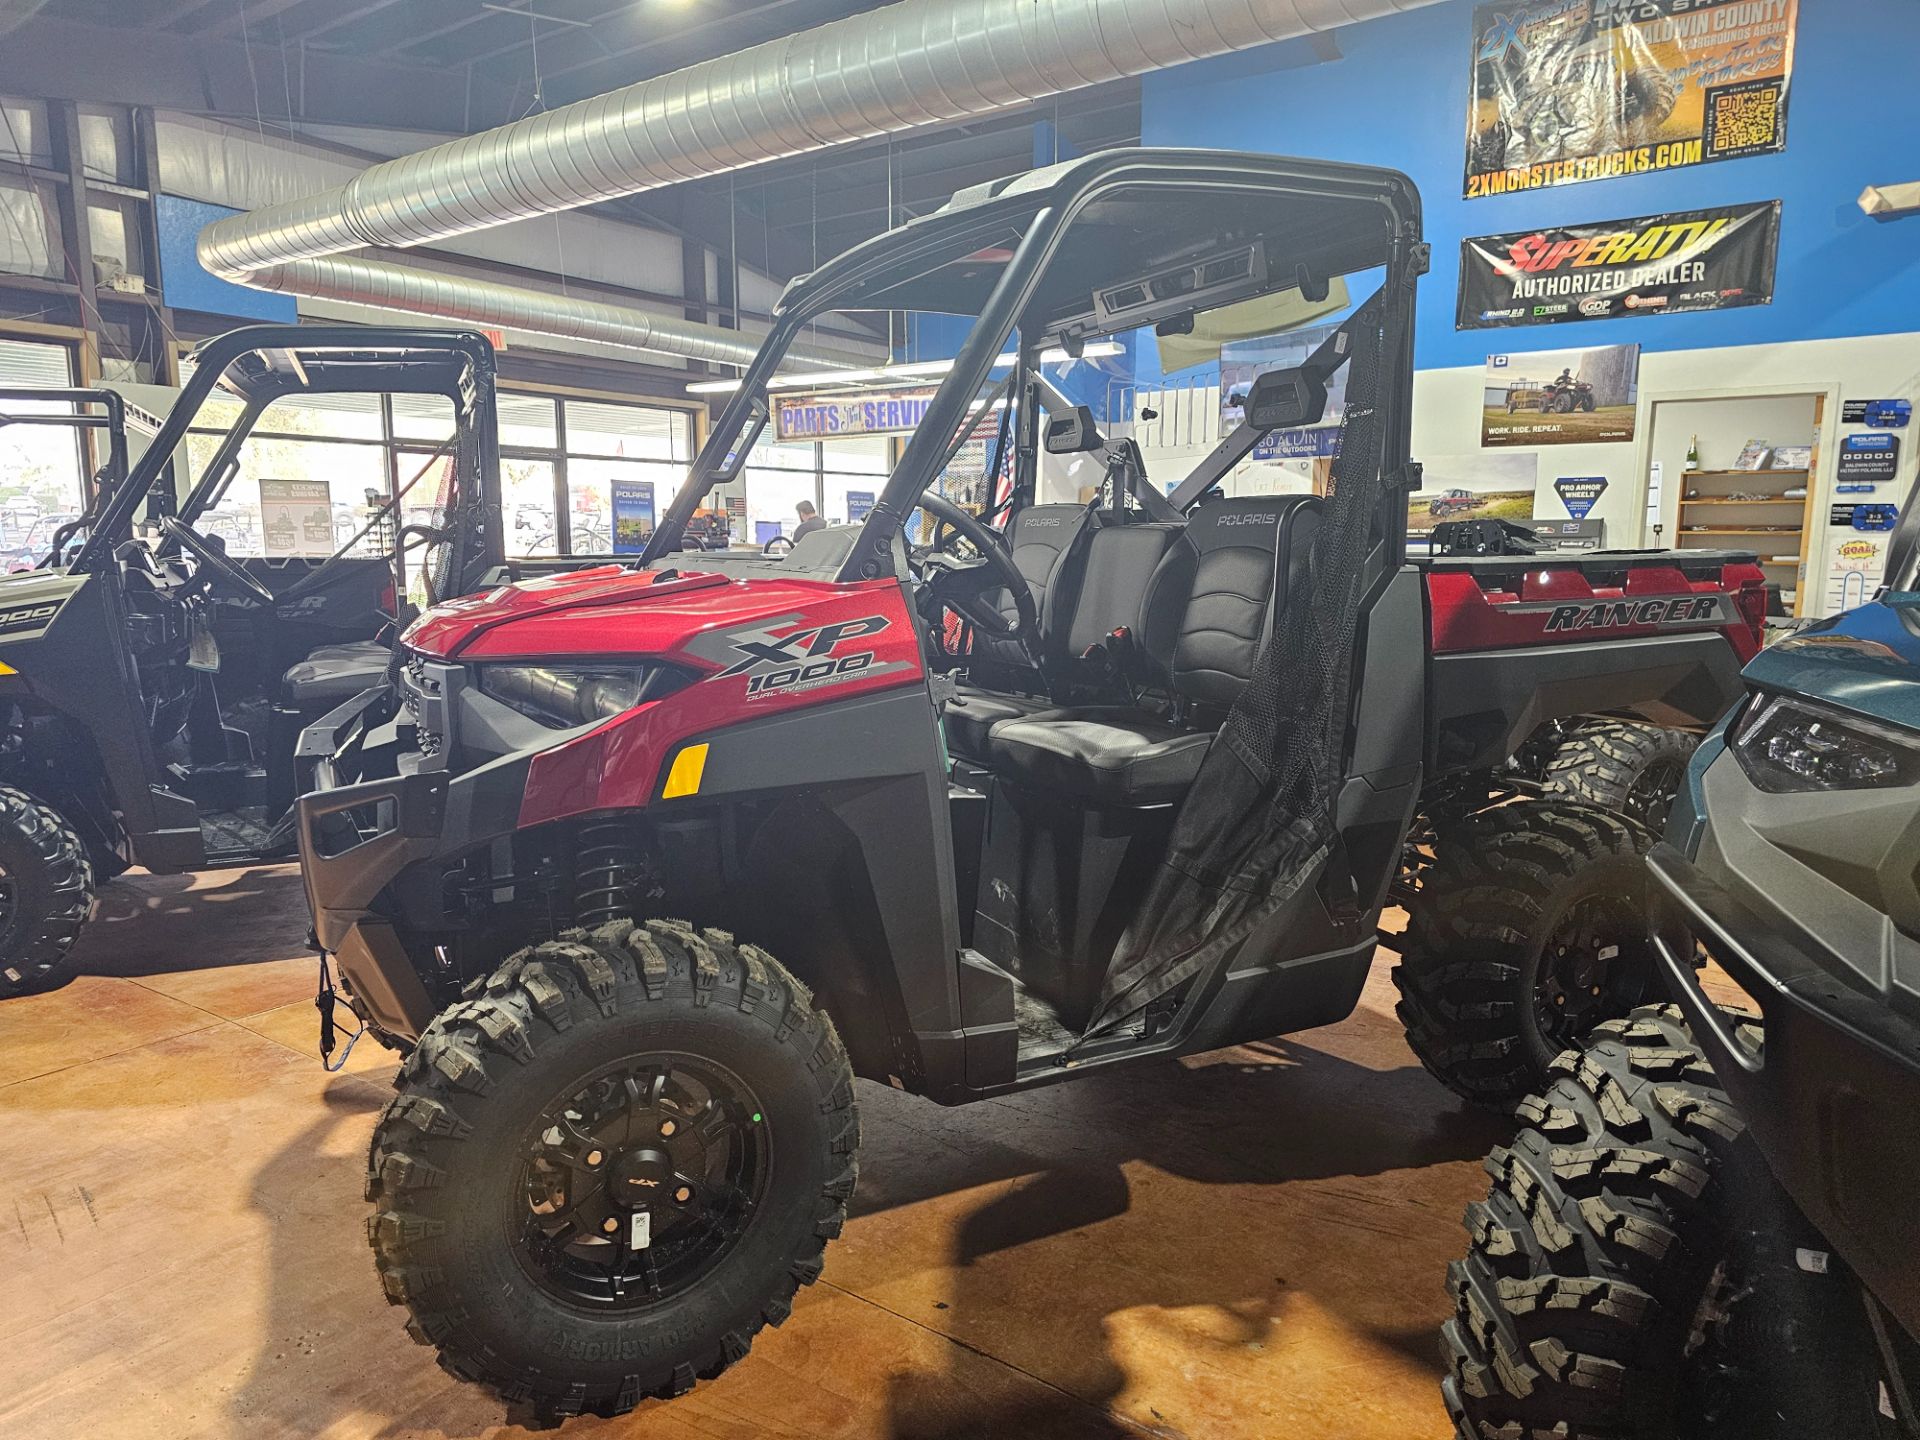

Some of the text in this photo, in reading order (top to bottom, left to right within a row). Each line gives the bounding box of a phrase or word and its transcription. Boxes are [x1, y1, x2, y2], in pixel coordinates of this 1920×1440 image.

[1636, 0, 1788, 46] ALDWIN COUNTY
[1753, 21, 1787, 38] ARENA
[1467, 138, 1703, 198] 2XMONSTERTRUCKS.COM
[1493, 218, 1731, 275] SUPERATV
[1512, 261, 1706, 299] AUTHORIZED DEALER
[783, 405, 839, 434] PARTS
[864, 400, 932, 429] SERVI
[1488, 425, 1563, 435] WORK. RIDE. REPEAT.
[1025, 518, 1060, 528] POLARIS
[1217, 514, 1276, 526] POLARIS
[1543, 597, 1720, 632] RANGER
[703, 614, 892, 683] XP
[746, 651, 875, 696] 1000
[746, 669, 868, 702] DUAL OVERHEAD CAM
